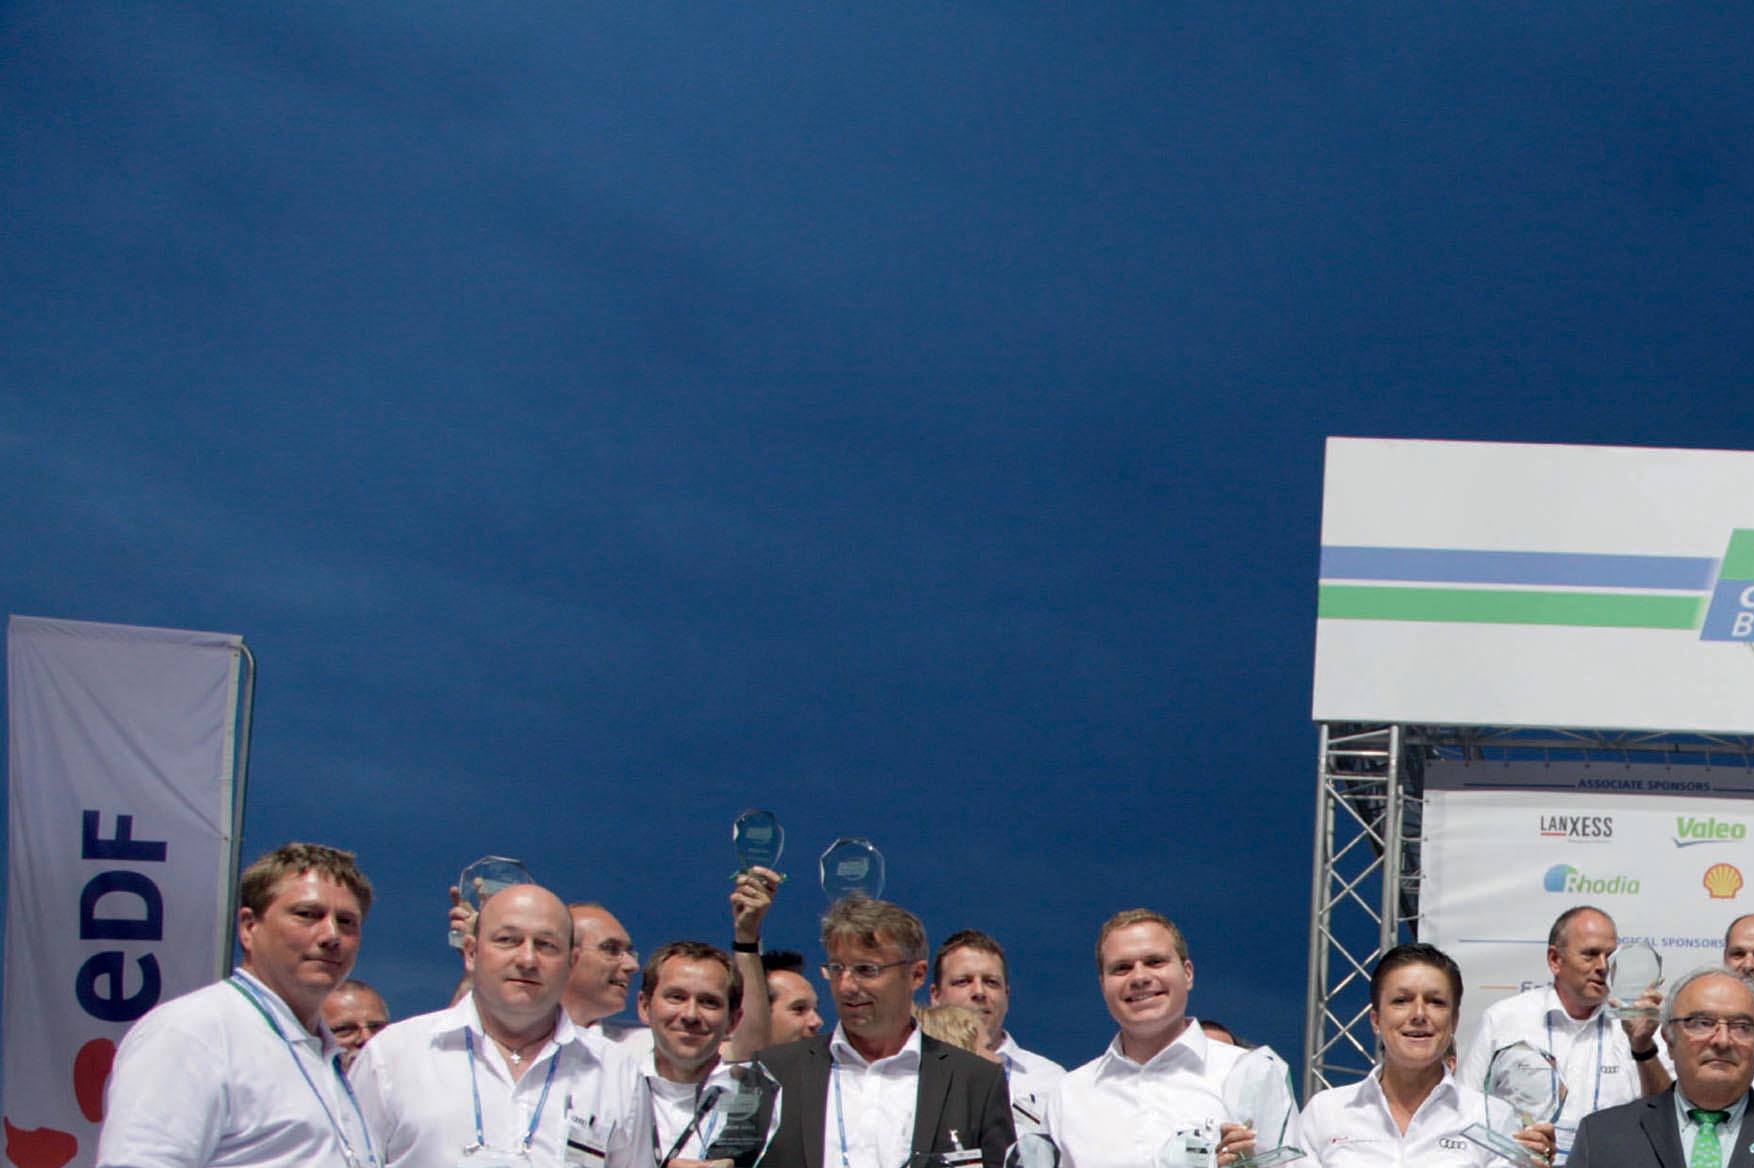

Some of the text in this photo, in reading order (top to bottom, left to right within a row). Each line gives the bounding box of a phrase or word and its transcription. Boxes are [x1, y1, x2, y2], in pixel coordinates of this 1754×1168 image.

[1576, 778, 1711, 792] ASSOCIATE SPONSORS
[1540, 815, 1613, 838] LANXESS
[1676, 816, 1747, 840] Valeo
[1567, 869, 1641, 895] Rhodia
